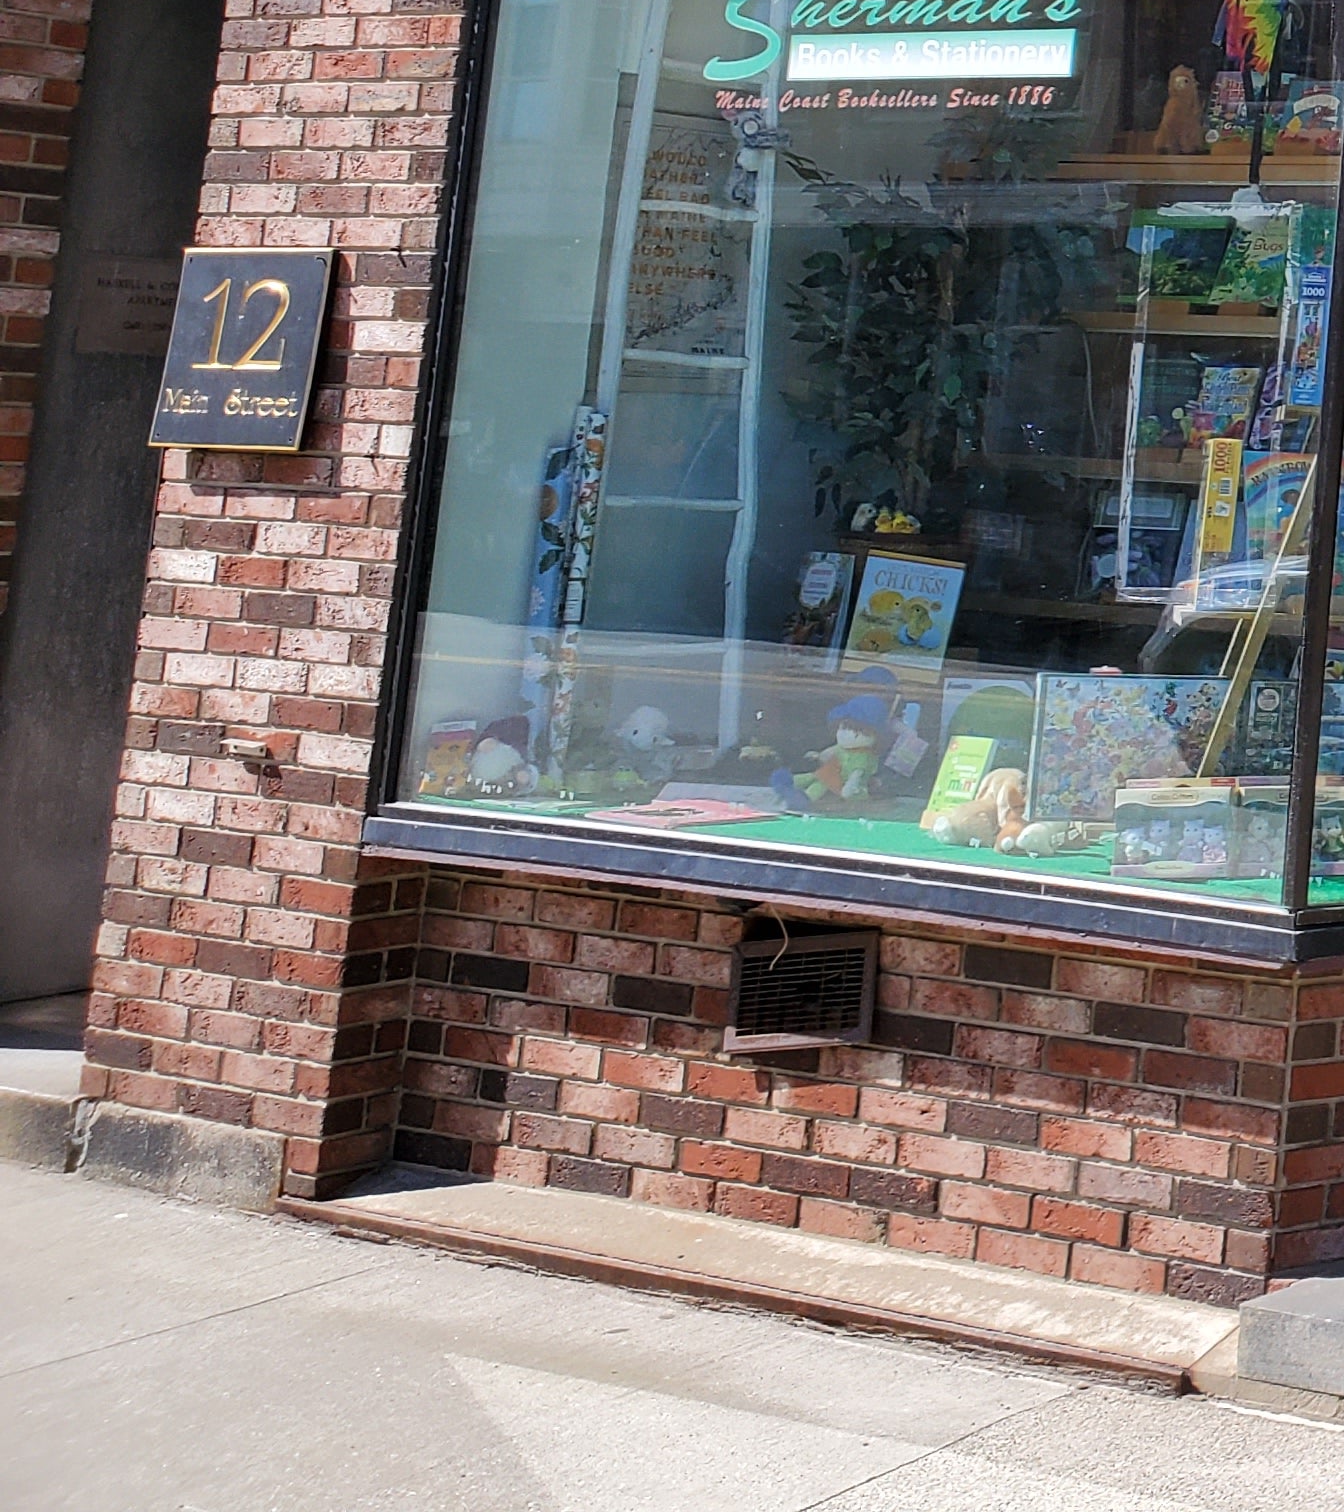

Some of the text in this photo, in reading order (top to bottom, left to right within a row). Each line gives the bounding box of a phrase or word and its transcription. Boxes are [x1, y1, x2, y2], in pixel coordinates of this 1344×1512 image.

[798, 40, 1067, 70] Books & Stationery
[779, 90, 830, 112] Coast
[837, 88, 938, 108] Booksellers
[947, 88, 999, 109] Since
[1008, 86, 1055, 106] 1886
[1252, 238, 1285, 252] Bugs
[1302, 286, 1326, 298] 1000
[191, 278, 290, 370] 12
[162, 388, 299, 417] Main Street
[1213, 441, 1228, 473] 1000
[874, 569, 949, 597] CHICKS!
